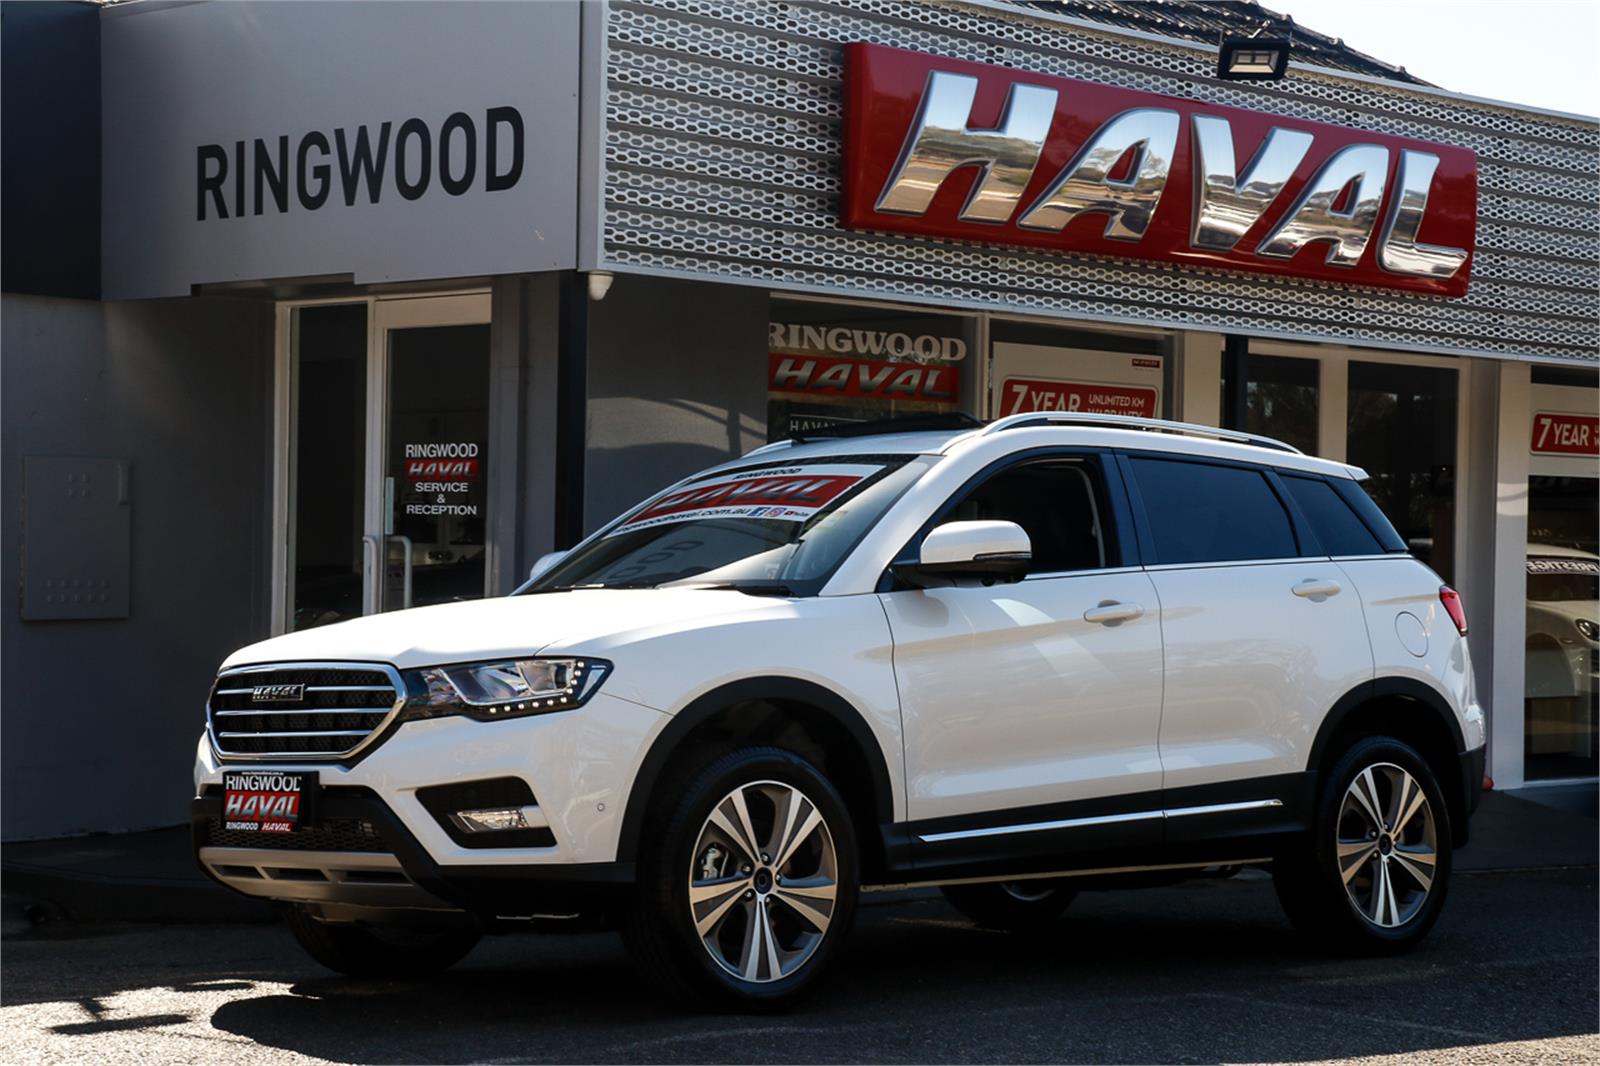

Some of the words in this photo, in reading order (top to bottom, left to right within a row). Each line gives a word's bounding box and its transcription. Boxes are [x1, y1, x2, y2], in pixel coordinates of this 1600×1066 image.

[196, 106, 525, 221] RINGWOOD
[874, 70, 1469, 279] HAVAL
[769, 322, 967, 361] RINGWOOD
[774, 358, 955, 398] HAVAL
[1010, 384, 1028, 415] 7
[1031, 391, 1081, 413] YEAR
[1088, 394, 1131, 407] UNLIMITED
[1131, 397, 1145, 408] KM
[1537, 418, 1552, 448] 7
[1553, 423, 1590, 447] YEAR
[405, 443, 478, 458] RINGWOOD
[409, 462, 475, 477] HAVAL
[415, 482, 469, 492] SERVICE
[436, 494, 446, 504] &
[650, 478, 836, 512] HAVAL
[406, 505, 477, 515] RECEPTION
[225, 794, 299, 821] HAVAL
[226, 822, 259, 831] RINGWOOD
[261, 822, 291, 832] HAVAL
